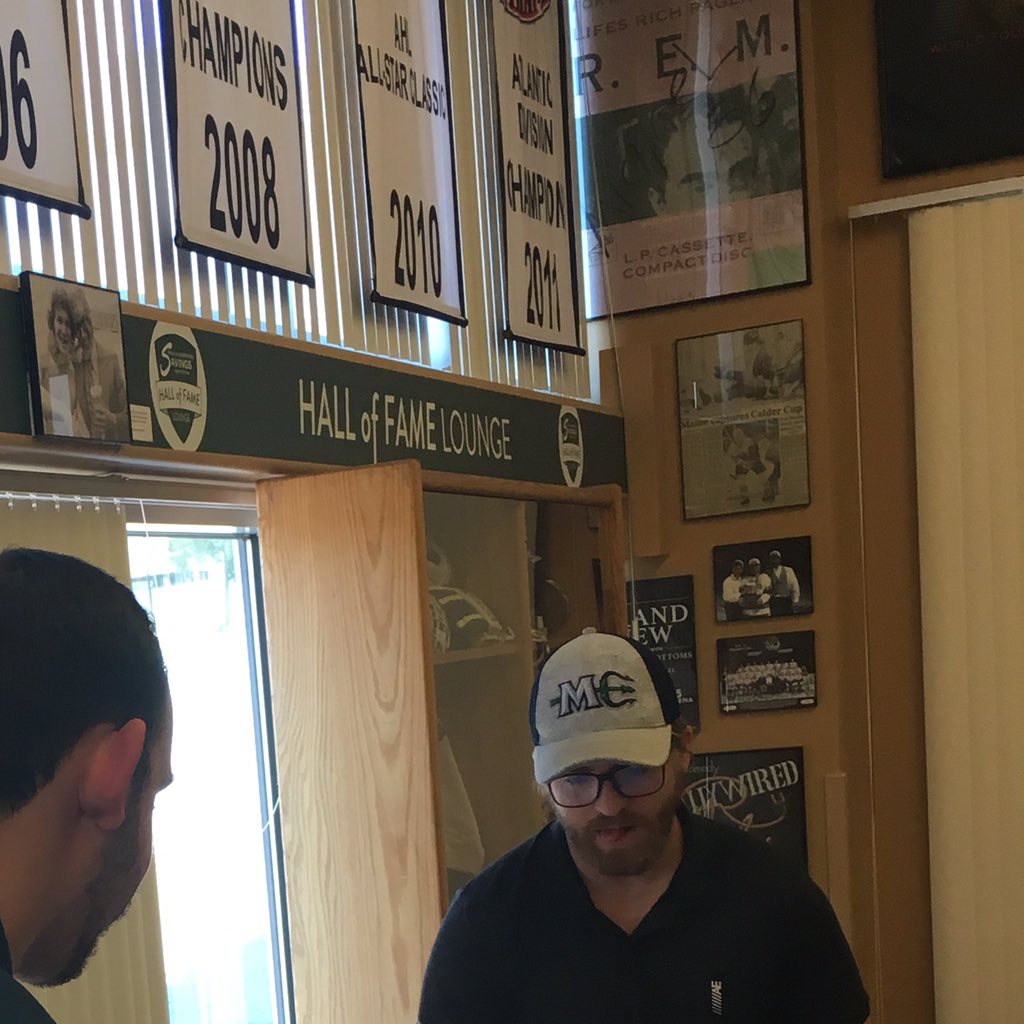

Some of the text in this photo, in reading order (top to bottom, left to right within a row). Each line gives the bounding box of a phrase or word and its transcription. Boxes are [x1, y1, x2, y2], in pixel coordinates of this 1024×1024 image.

[179, 0, 288, 111] CHAMPIONS
[394, 13, 412, 57] AHL
[204, 114, 280, 250] 2008
[390, 189, 442, 298] 2010
[623, 255, 707, 280] COMPACT
[524, 242, 561, 332] 2011
[158, 387, 175, 401] HALL
[182, 388, 201, 406] FAME
[299, 378, 356, 441] HALL
[361, 391, 379, 465] of
[384, 395, 437, 450] FAME
[441, 408, 512, 461] LOUNGE
[783, 404, 804, 416] Cup
[636, 604, 689, 626] AND
